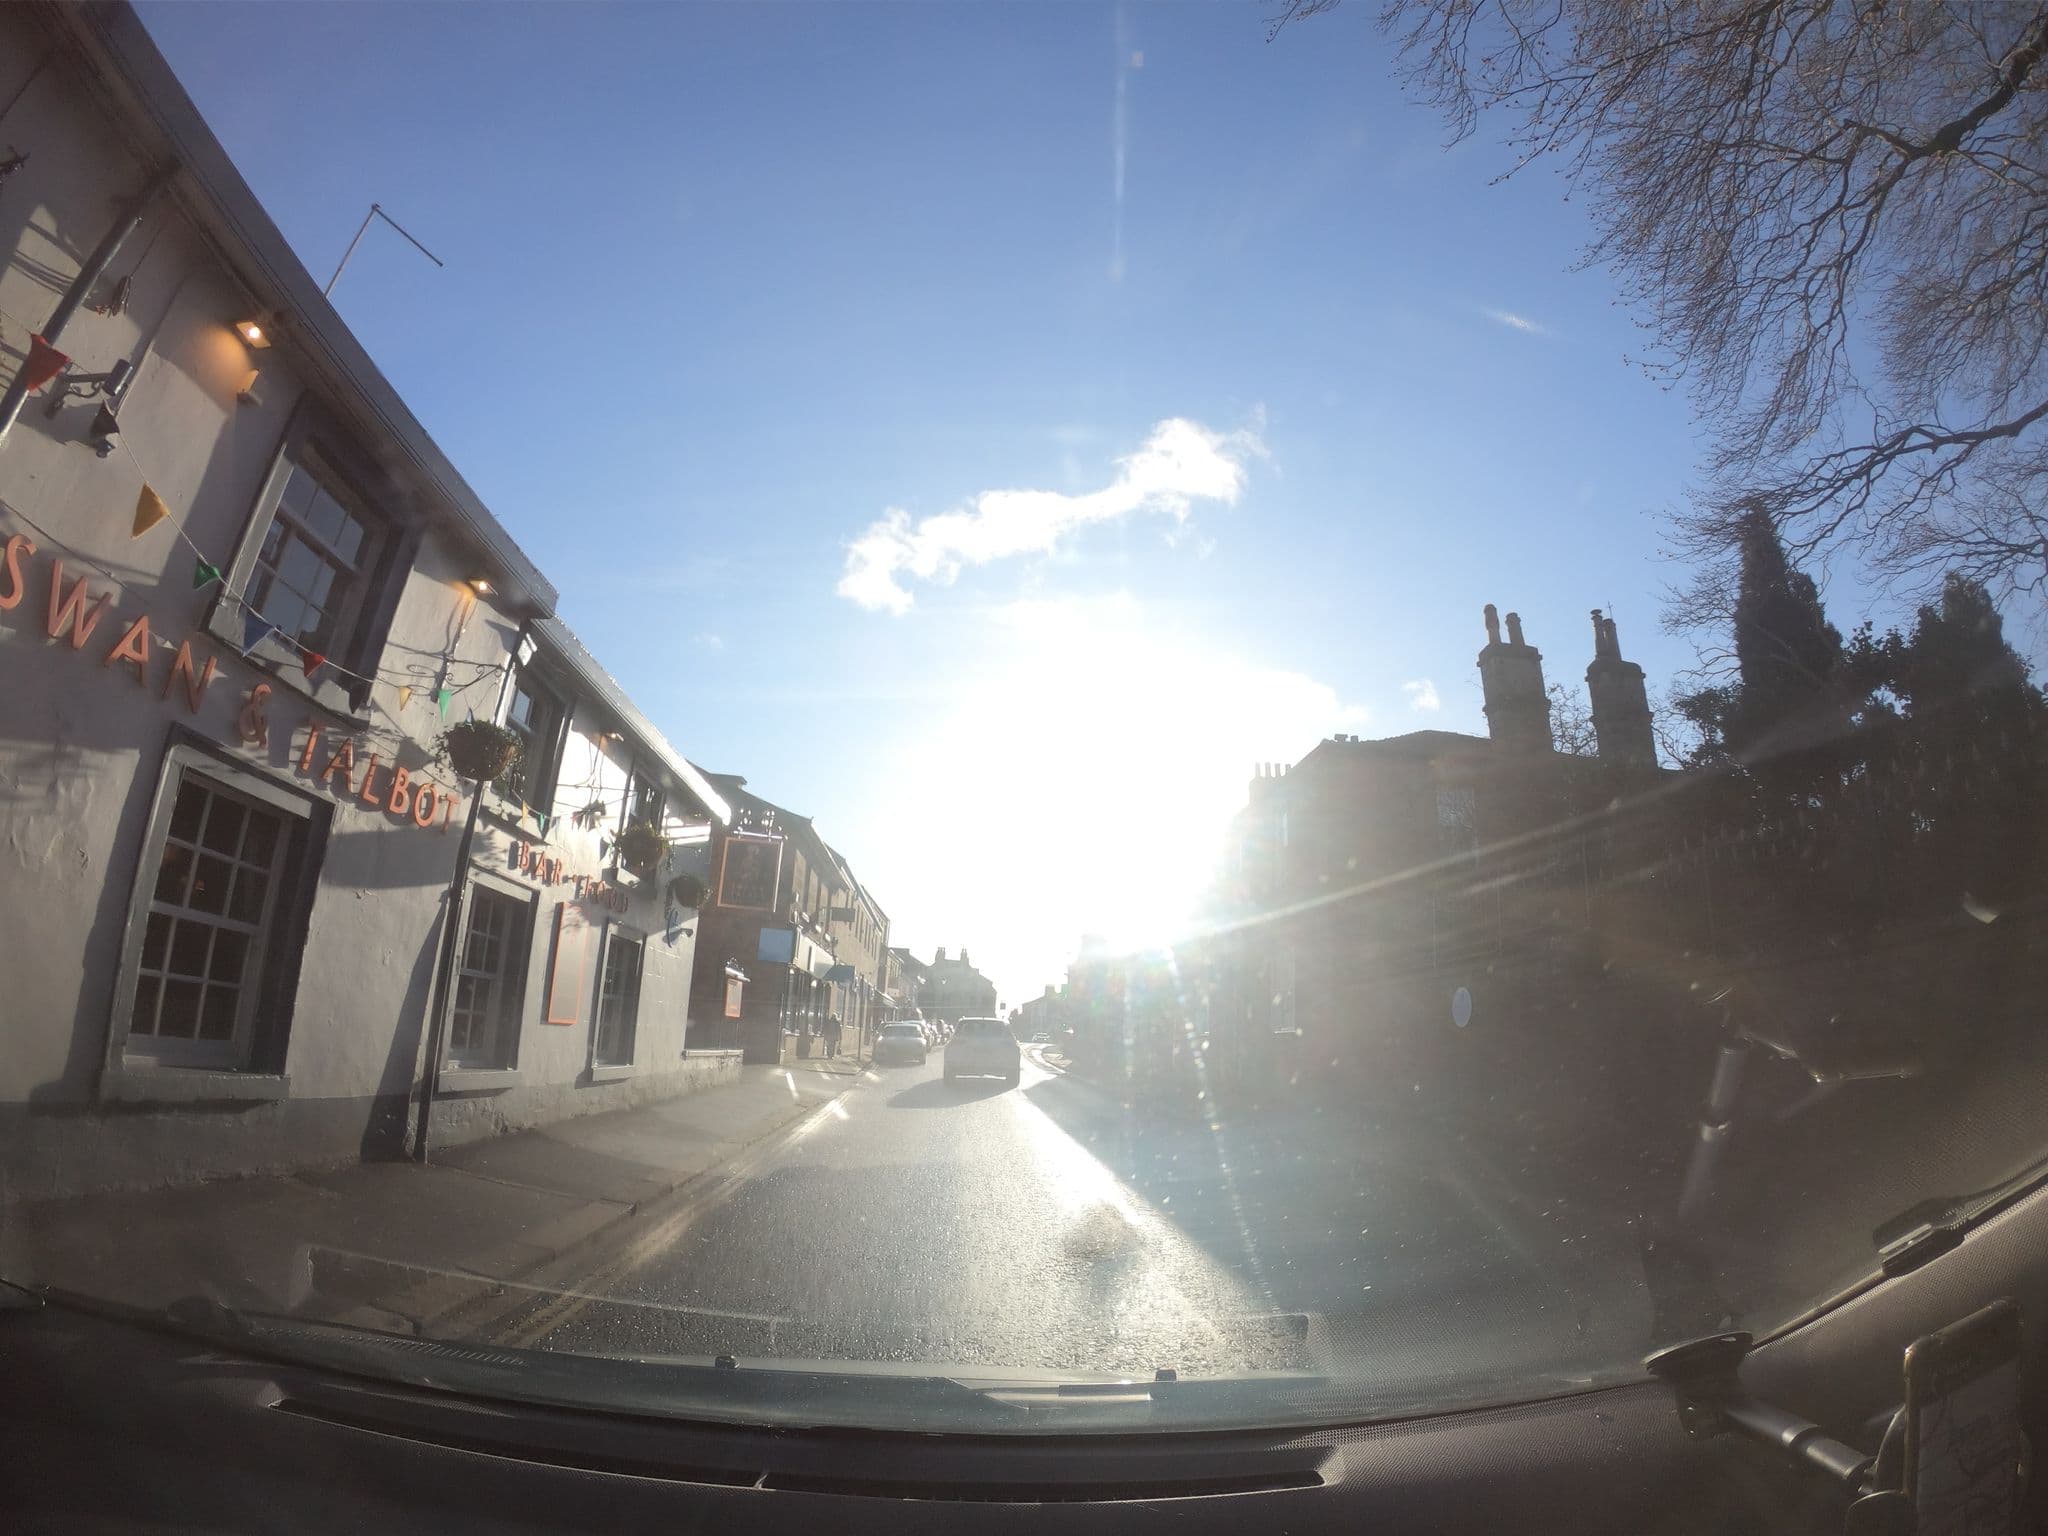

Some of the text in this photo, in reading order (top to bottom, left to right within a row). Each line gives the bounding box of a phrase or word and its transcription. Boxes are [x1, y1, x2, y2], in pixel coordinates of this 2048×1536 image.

[0, 533, 459, 832] SWAN & TALBOT
[519, 840, 562, 886] BAR
